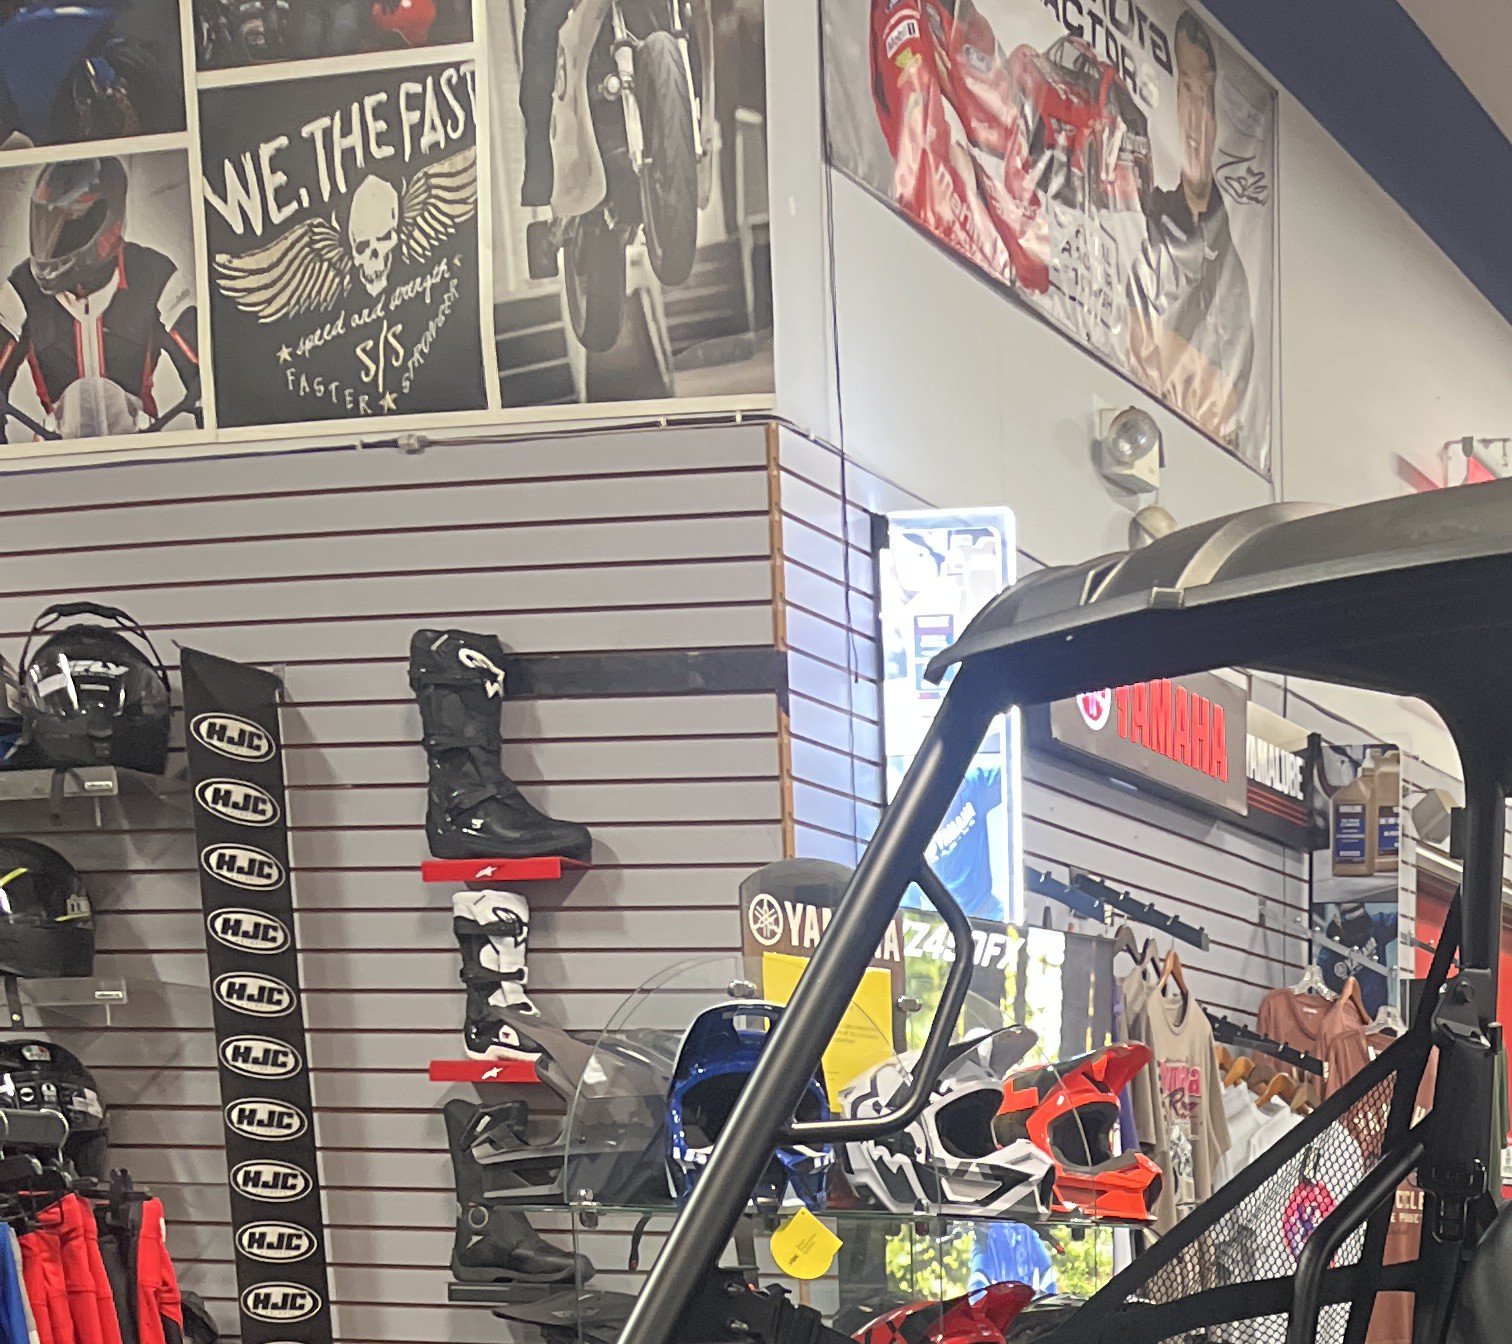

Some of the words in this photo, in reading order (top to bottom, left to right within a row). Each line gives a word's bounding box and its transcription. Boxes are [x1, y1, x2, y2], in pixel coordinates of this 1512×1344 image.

[202, 135, 309, 236] WE,
[301, 91, 395, 202] THE
[400, 60, 477, 163] FAST
[296, 310, 346, 359] speed
[351, 294, 385, 328] and
[388, 257, 451, 311] strength
[286, 367, 373, 415] FASTER
[401, 278, 459, 394] STRONGER
[206, 721, 263, 751] HJC
[1115, 677, 1229, 783] YAMAHA
[1246, 733, 1305, 800] AMALUBE
[211, 787, 268, 816] HJC
[216, 852, 273, 880] HJC
[221, 917, 279, 943] HJC
[226, 981, 284, 1007] HJC
[231, 1044, 289, 1068] HJC
[236, 1108, 294, 1130] HJC
[242, 1170, 299, 1190] HJC
[248, 1231, 303, 1251] HJC
[252, 1292, 306, 1310] HJC
